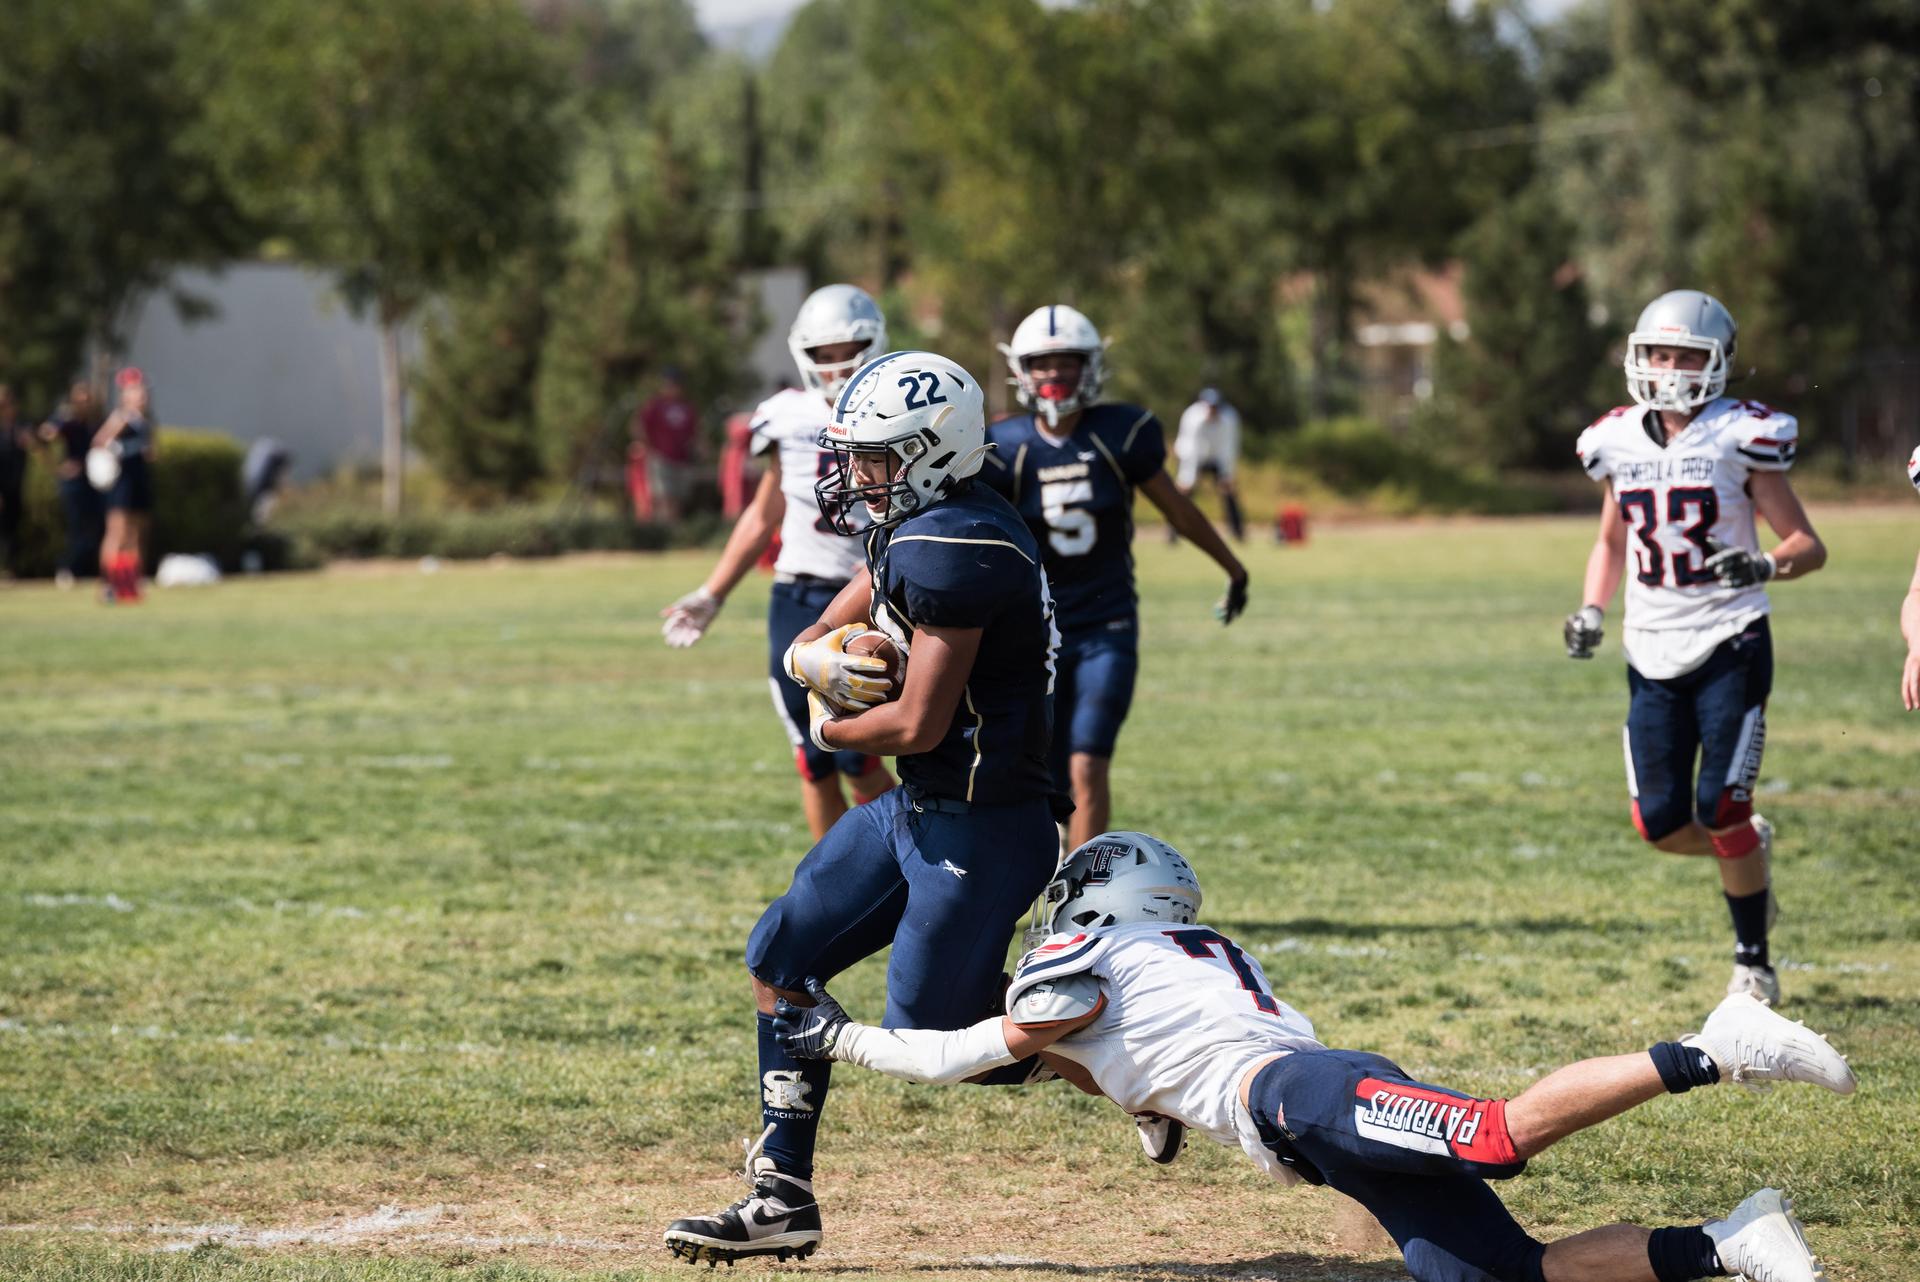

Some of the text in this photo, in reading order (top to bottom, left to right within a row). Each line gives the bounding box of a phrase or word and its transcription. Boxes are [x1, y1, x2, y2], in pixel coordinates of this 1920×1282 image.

[898, 371, 947, 410] 22
[1041, 480, 1097, 556] 5
[1620, 486, 1719, 587] 33
[1160, 929, 1280, 1016] 7
[763, 1109, 814, 1120] ACADEMY
[1363, 1090, 1482, 1145] PATRIOTS
